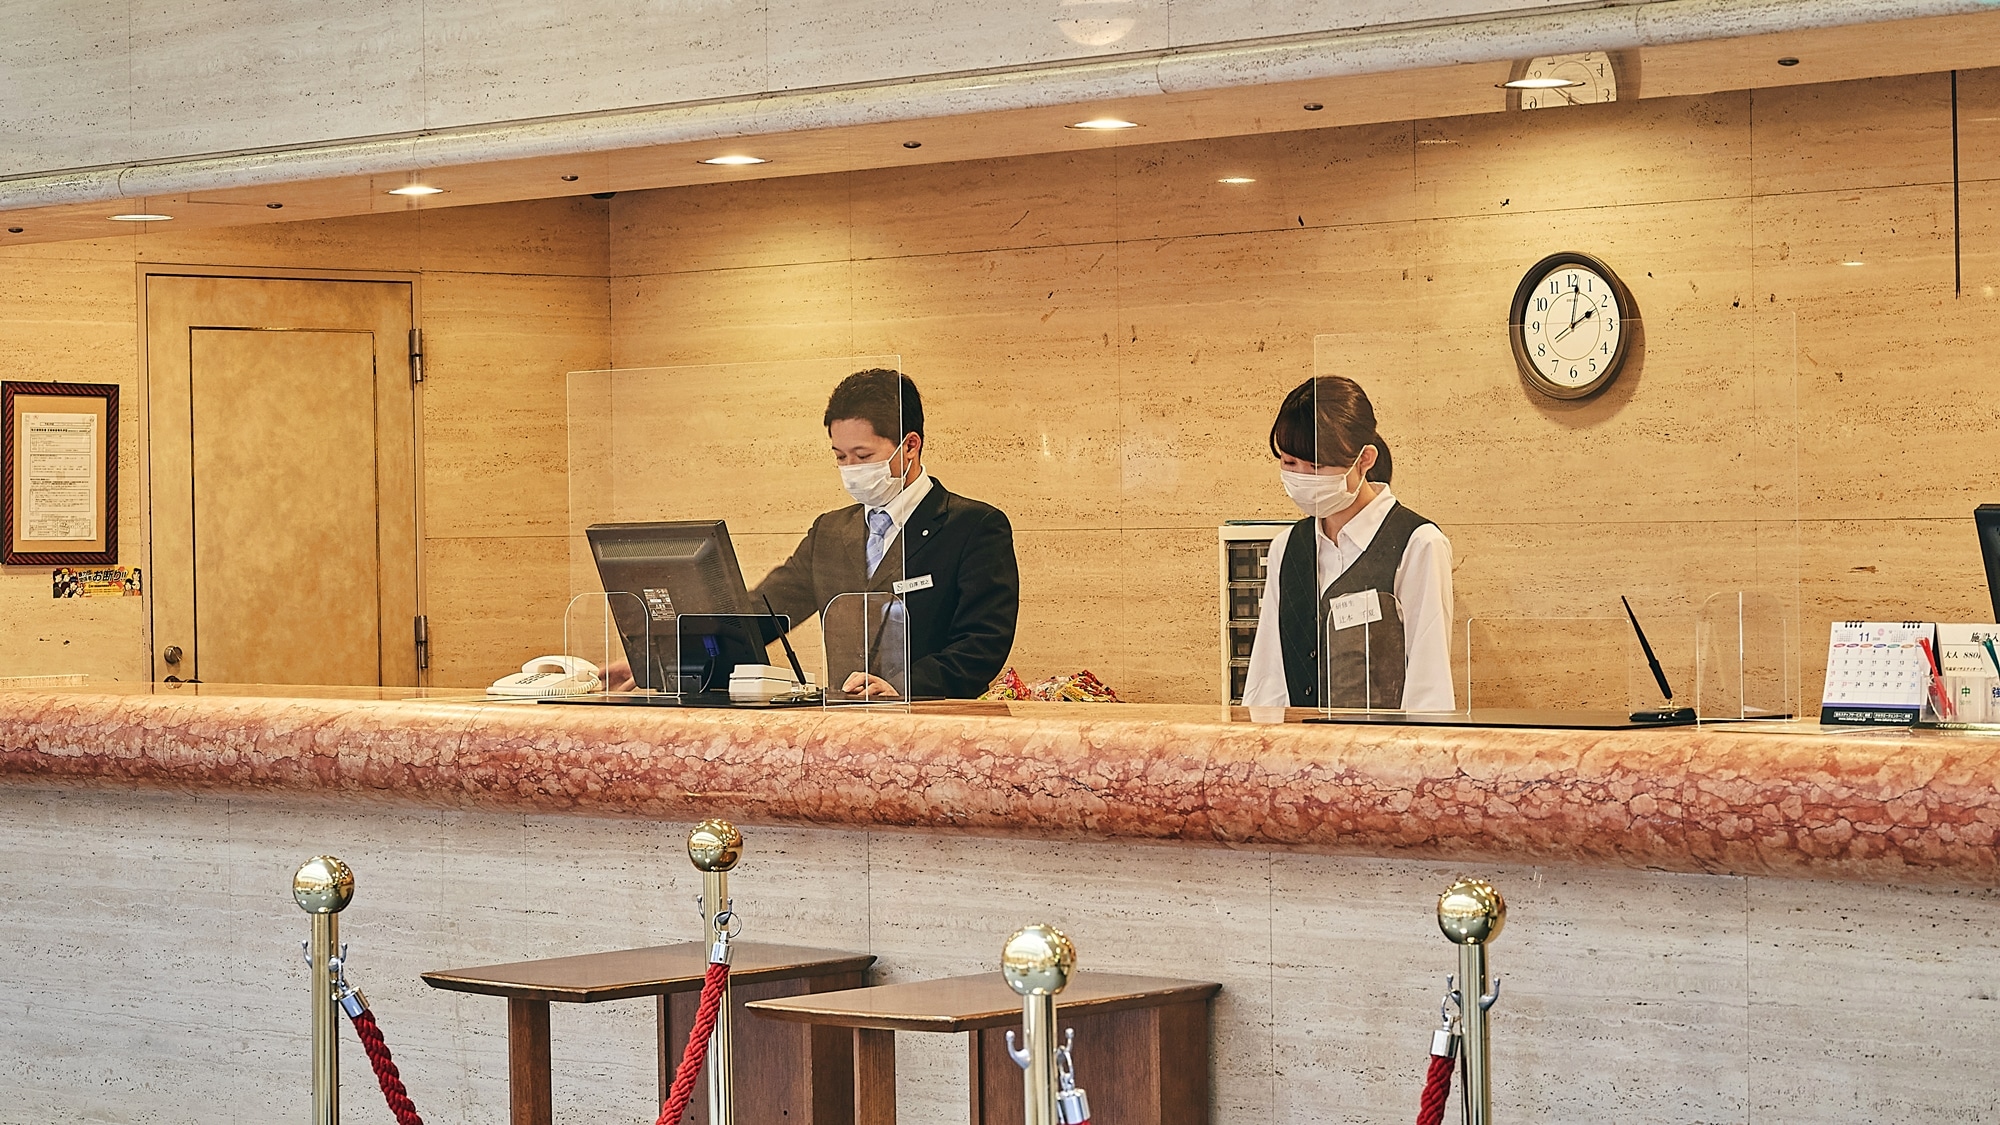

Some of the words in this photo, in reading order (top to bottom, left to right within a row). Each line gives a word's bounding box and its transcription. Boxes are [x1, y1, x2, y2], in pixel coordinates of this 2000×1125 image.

[1550, 281, 1559, 294] 11
[1567, 274, 1578, 288] 12
[1588, 279, 1592, 292] 1
[1536, 297, 1548, 311] 10
[1601, 294, 1608, 308] 2
[1532, 321, 1540, 334] 9
[1606, 318, 1613, 331] 3
[1537, 343, 1546, 357] 8
[1600, 341, 1608, 355] 4
[1551, 360, 1559, 373] 7
[1570, 365, 1578, 378] 6
[1588, 358, 1596, 372] 5
[1859, 632, 1870, 642] 11
[1961, 686, 1971, 697] 中
